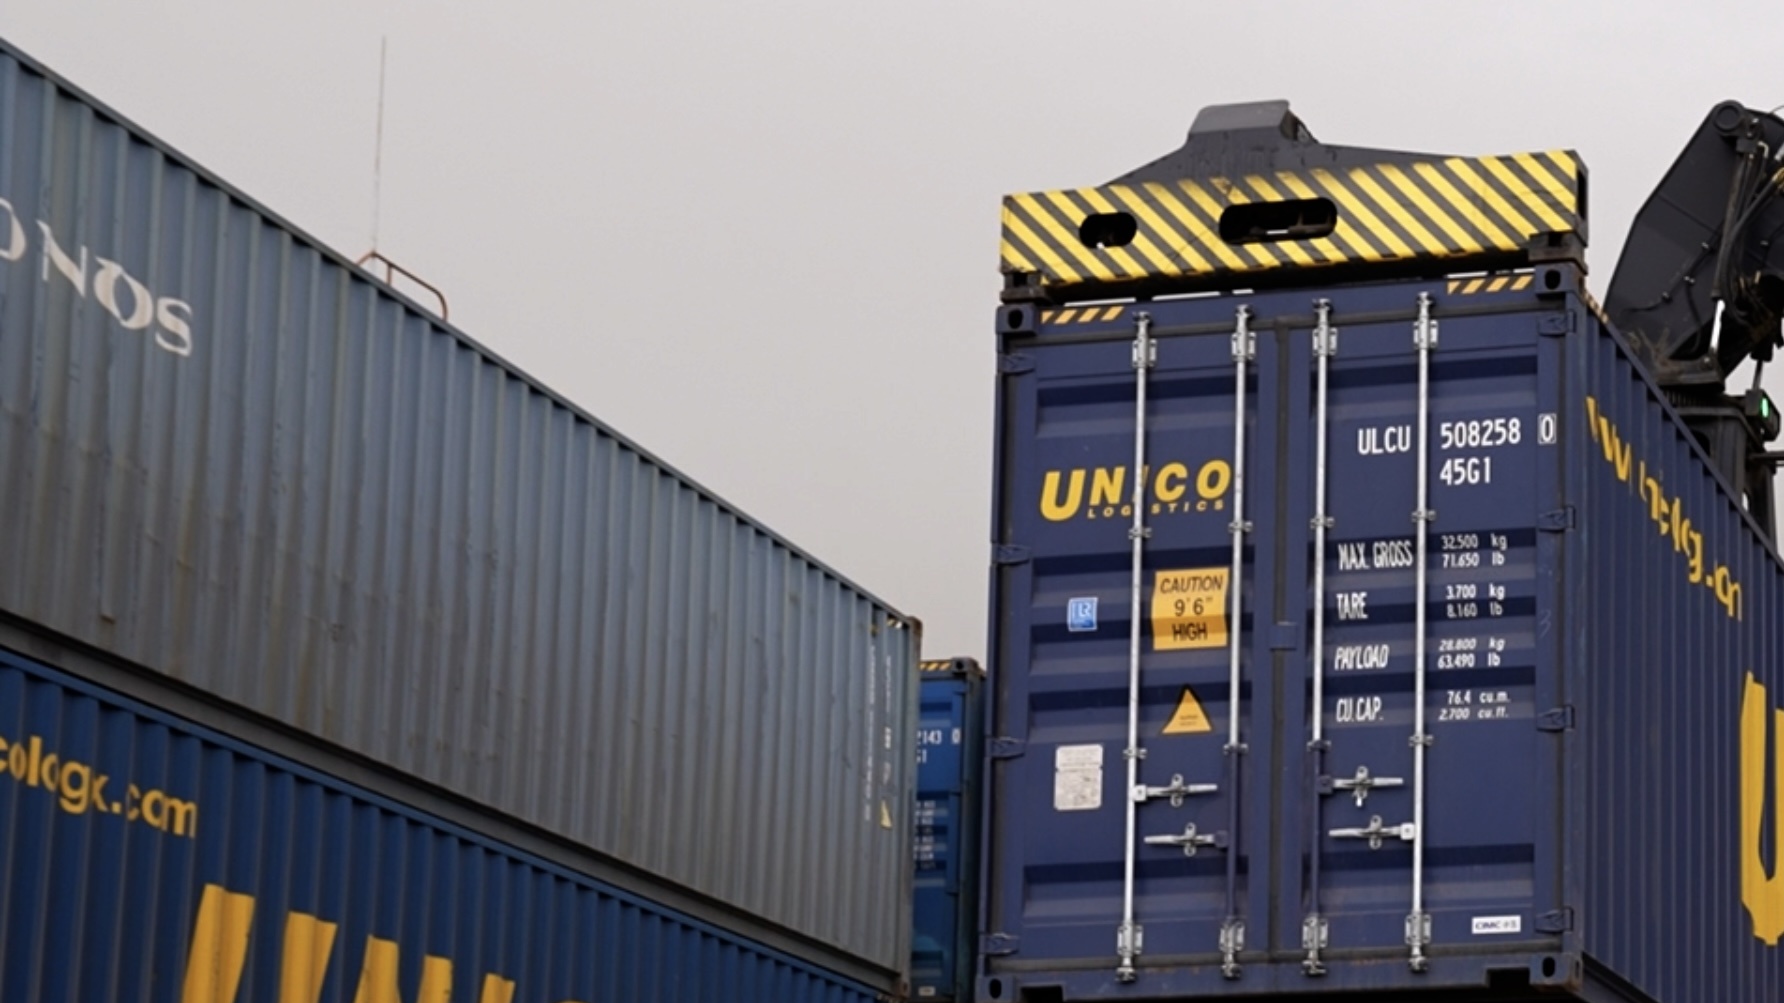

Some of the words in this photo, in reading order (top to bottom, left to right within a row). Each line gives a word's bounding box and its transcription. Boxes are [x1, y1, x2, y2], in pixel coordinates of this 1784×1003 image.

[1358, 425, 1411, 455] ULCU
[1440, 417, 1522, 449] 508258
[1539, 415, 1556, 443] 0
[1439, 456, 1491, 486] 45G1
[1087, 500, 1225, 519] LOGSTICS
[1490, 533, 1507, 549] kg
[1372, 540, 1414, 569] GROSS
[1491, 551, 1505, 566] lb
[1160, 575, 1223, 594] CAUTION
[1488, 583, 1506, 600] kg
[1336, 591, 1368, 620] TARE
[1489, 601, 1503, 616] lb
[1172, 622, 1208, 642] HIGH
[1488, 637, 1506, 652] kg
[1334, 644, 1390, 671] PAYLOAD
[1487, 653, 1501, 668] lb
